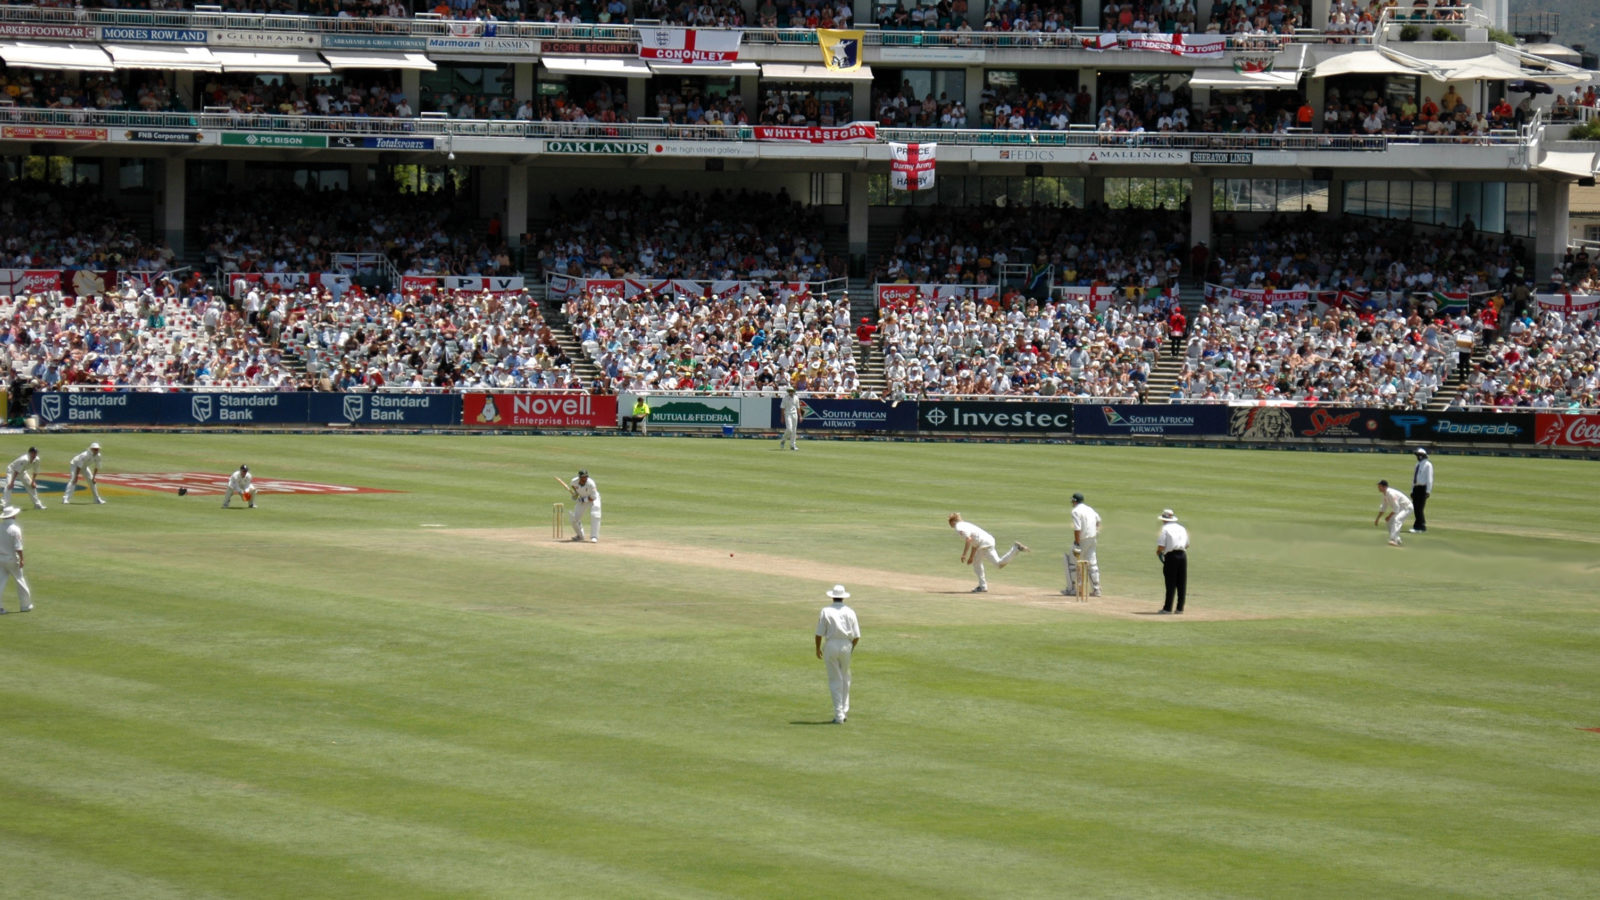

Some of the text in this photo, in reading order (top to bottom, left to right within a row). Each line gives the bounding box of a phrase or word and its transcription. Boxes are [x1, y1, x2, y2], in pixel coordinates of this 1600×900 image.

[31, 27, 84, 37] FOOTWEAR
[104, 29, 205, 41] MOORES ROWLAND
[429, 39, 481, 48] Marmoran
[484, 41, 530, 49] GLASSMEN
[553, 43, 632, 53] CORE SECURITY
[1196, 43, 1222, 52] TOWN
[656, 49, 725, 61] CONONLEY
[138, 131, 189, 140] FNB Corporate
[763, 127, 866, 140] WHITTLESFORD
[260, 136, 303, 145] PG BISON
[549, 142, 648, 154] OAKLANDS
[896, 146, 930, 155] PRINCE
[1011, 150, 1055, 161] FEDICS
[1100, 150, 1184, 160] MALLINICKS
[1192, 152, 1229, 163] SHERATON
[68, 394, 127, 406] Standard
[219, 394, 278, 407] Standard
[371, 395, 430, 408] Standard
[513, 396, 591, 415] Novell
[68, 408, 102, 420] Bank
[219, 408, 253, 421] Bank
[371, 409, 404, 421] Bank
[822, 409, 887, 419] SOUTH AFRICAN
[953, 407, 1068, 428] Investec
[1129, 415, 1194, 424] SOUTH AFRICAN
[513, 416, 591, 425] Enterprise Linux
[822, 419, 856, 428] AIRWAYS
[1129, 425, 1164, 433] AIRWAYS
[1436, 419, 1519, 435] Powerade
